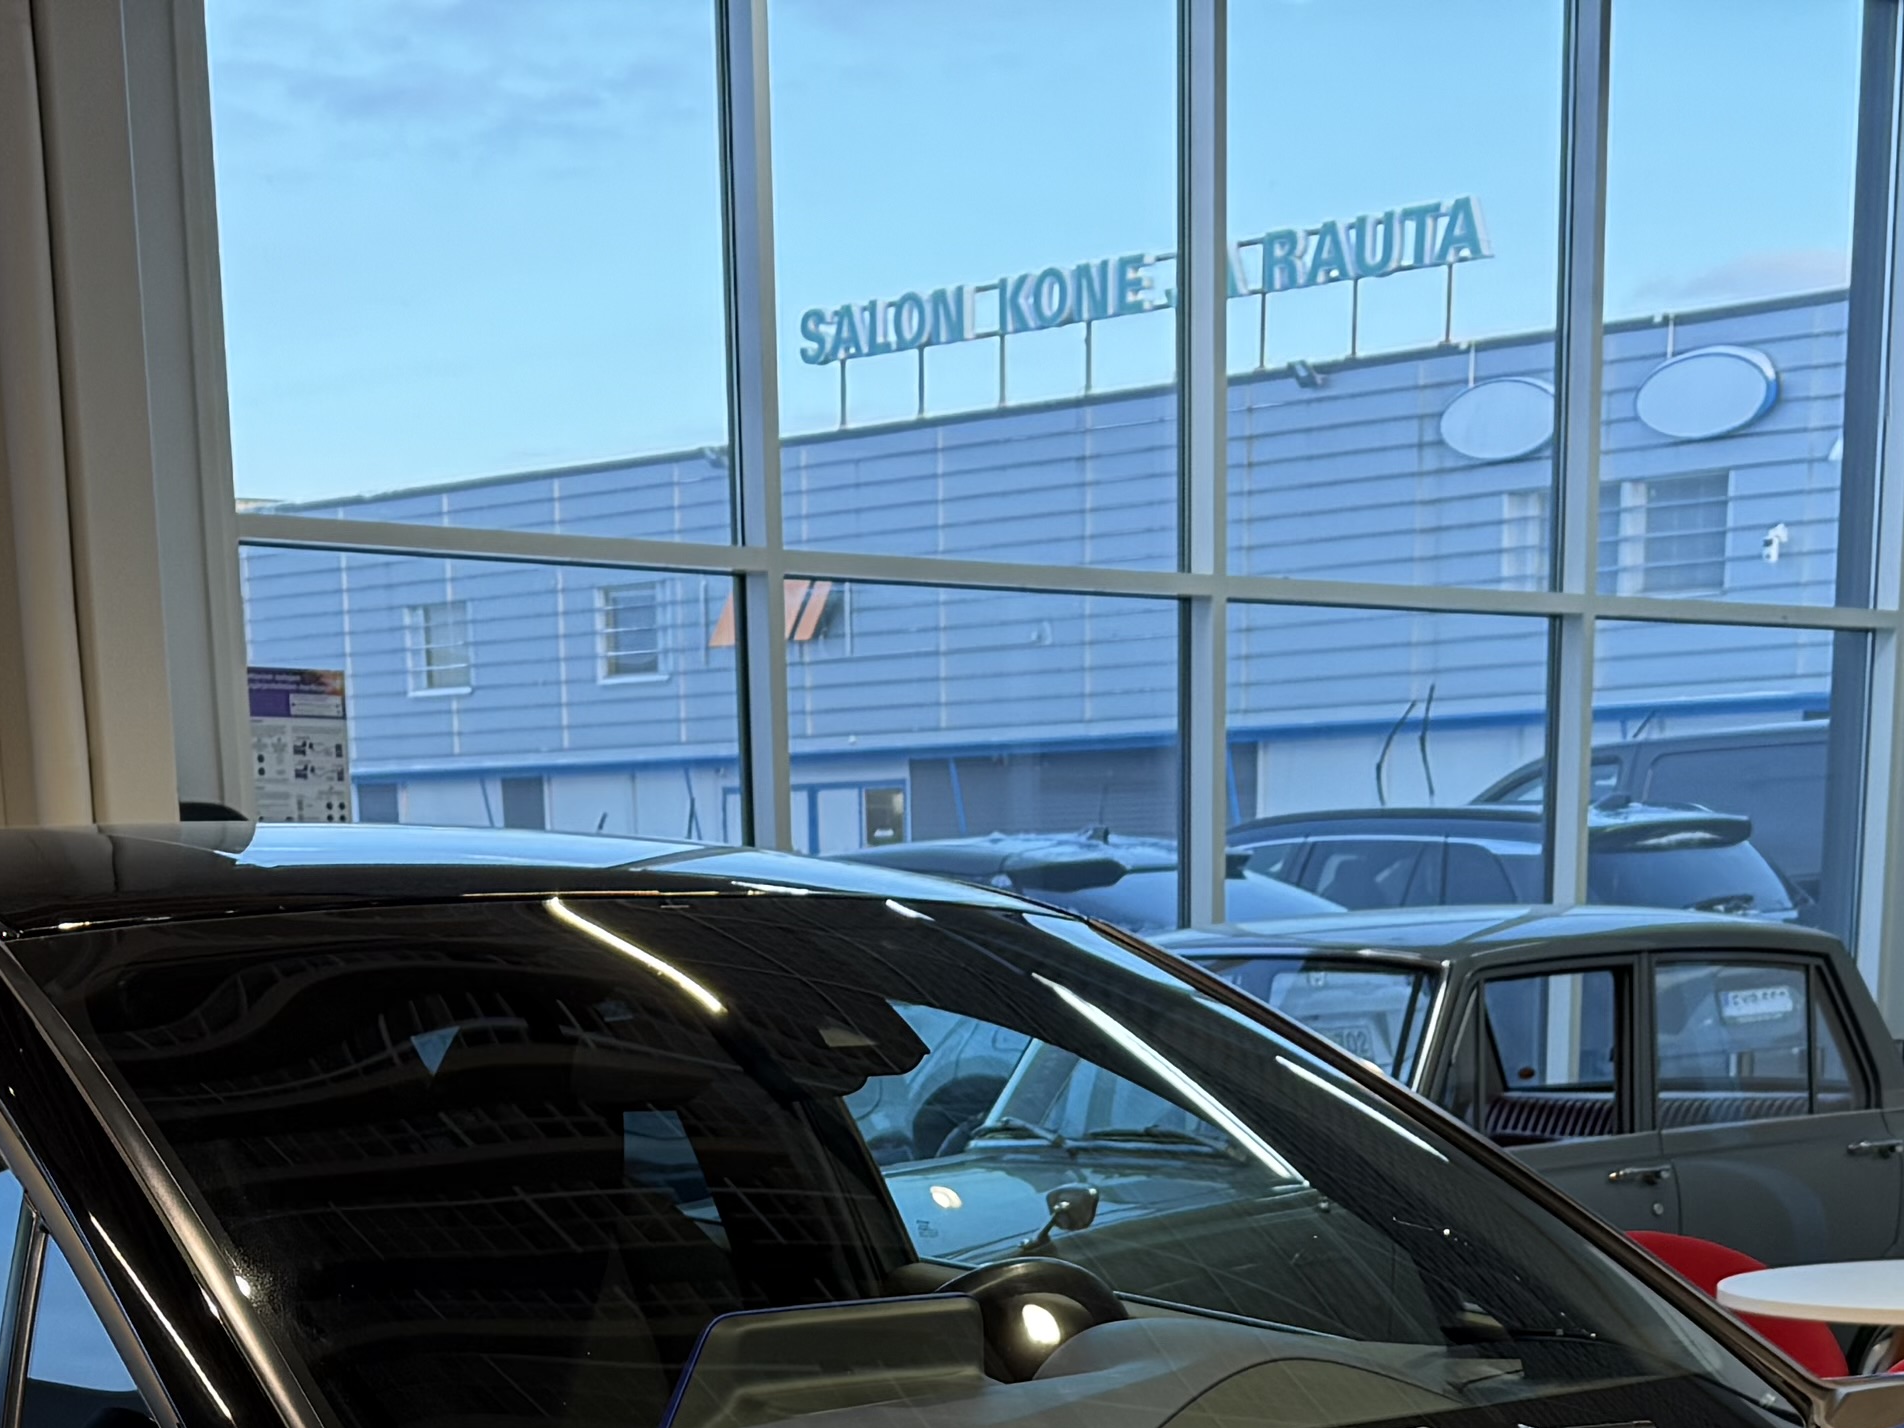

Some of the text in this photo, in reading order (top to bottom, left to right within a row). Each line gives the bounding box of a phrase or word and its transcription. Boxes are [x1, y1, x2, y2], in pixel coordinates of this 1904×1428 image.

[800, 285, 974, 365] SALON
[999, 253, 1153, 334] KONE
[1263, 195, 1492, 292] RAUTA
